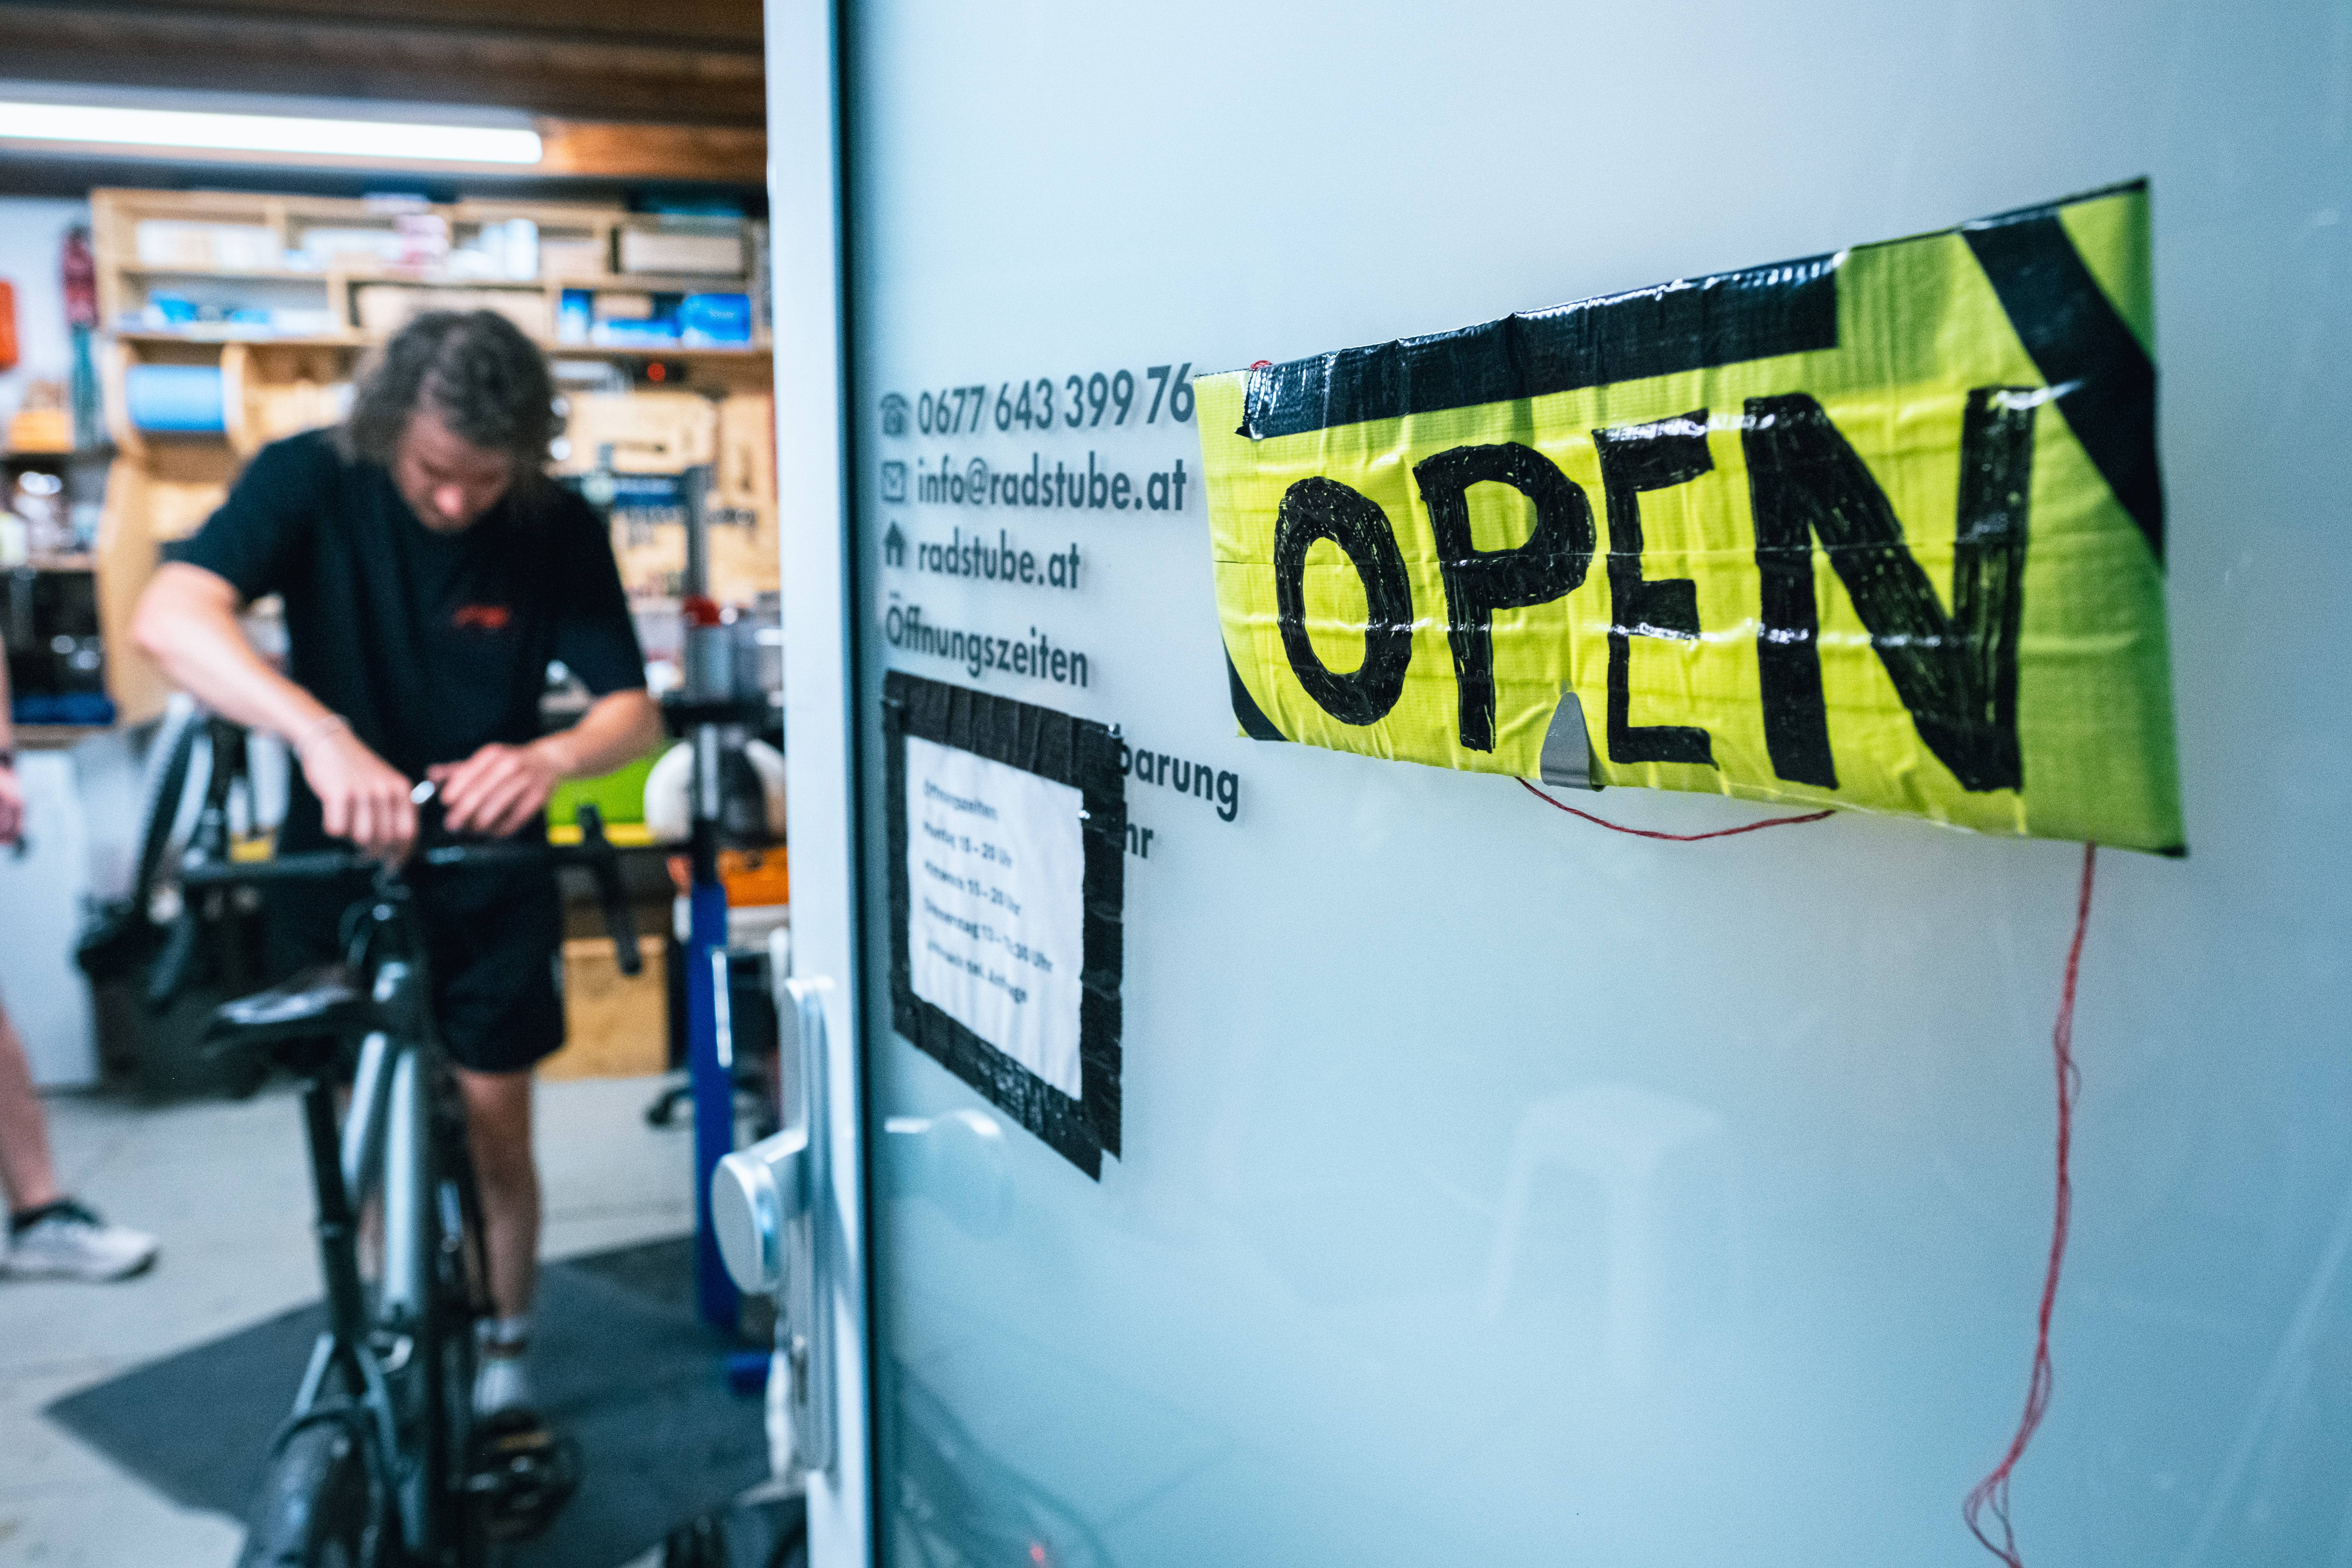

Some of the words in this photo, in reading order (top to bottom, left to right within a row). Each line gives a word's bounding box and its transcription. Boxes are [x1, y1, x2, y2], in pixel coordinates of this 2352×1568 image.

[917, 385, 986, 436] 0677
[994, 378, 1054, 431] 643
[1064, 369, 1135, 428] 399
[1147, 362, 1195, 424] 76
[917, 451, 1187, 511] info@radstube.at
[918, 527, 1081, 589] radstube.at
[1274, 386, 2036, 793] OPEN
[886, 591, 1088, 688] Öffnungszeiten
